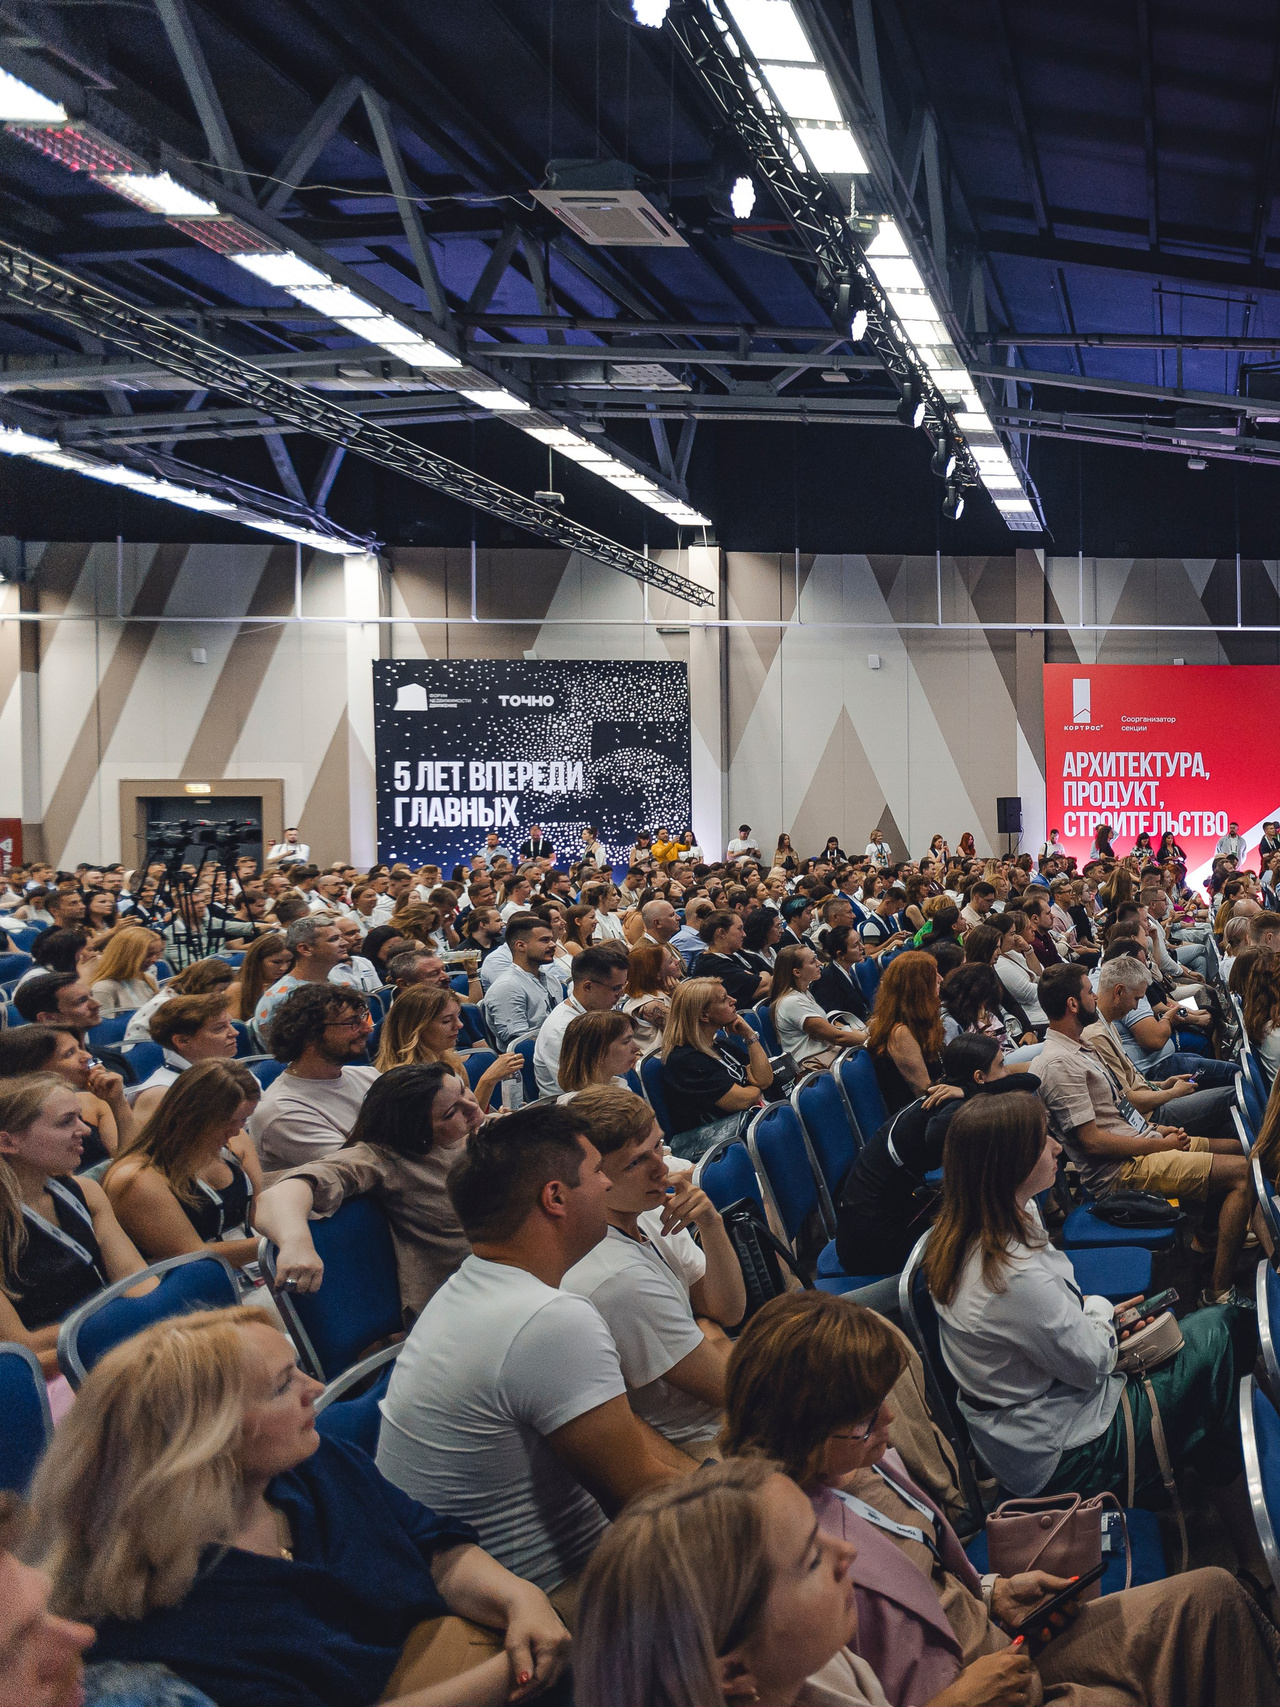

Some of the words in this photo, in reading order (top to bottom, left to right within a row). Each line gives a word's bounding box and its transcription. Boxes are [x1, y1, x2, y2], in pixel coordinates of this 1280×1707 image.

[498, 695, 555, 707] ТОЧНО
[1121, 715, 1177, 724] Соорганизатор
[393, 761, 411, 791] 5
[415, 761, 464, 791] ЛЕТ
[469, 761, 584, 794] ВПЕРЕДИ
[1063, 752, 1210, 780] АРХИТЕКТУРА,
[1063, 781, 1165, 809] ПРОДУКТ,
[394, 797, 520, 827] ГЛАВНЫХ
